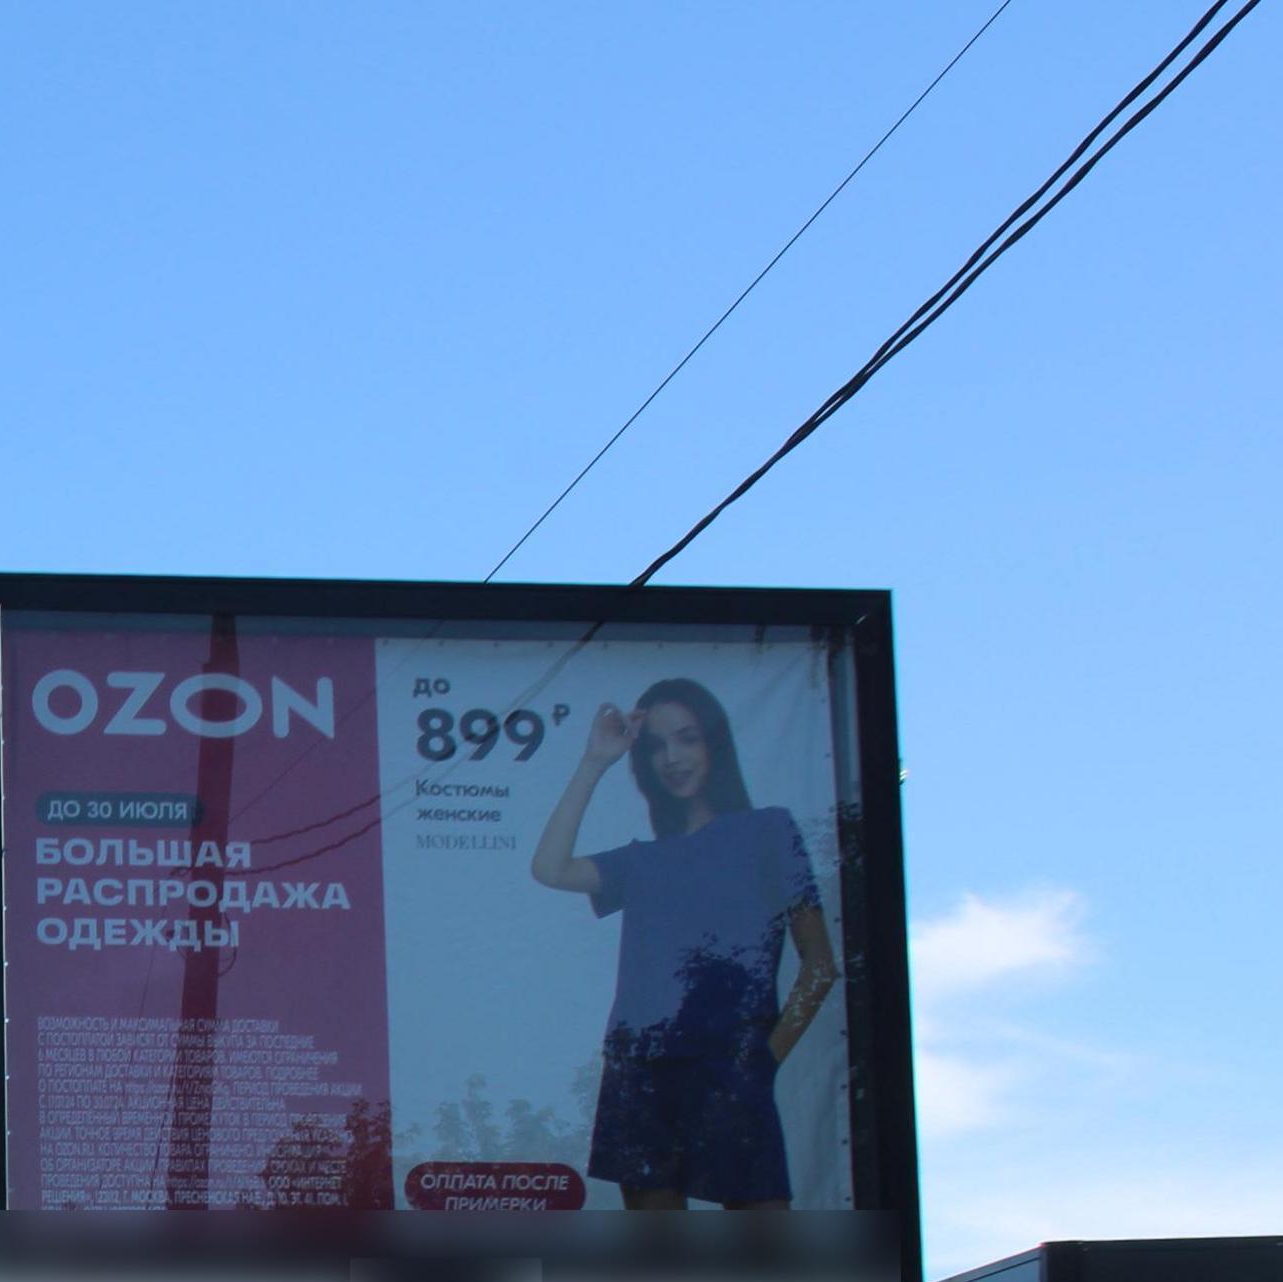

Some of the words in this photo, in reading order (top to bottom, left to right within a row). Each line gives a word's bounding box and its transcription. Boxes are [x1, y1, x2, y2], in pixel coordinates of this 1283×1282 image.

[32, 669, 334, 739] OZON
[415, 780, 510, 799] Костюмы
[47, 800, 80, 820] ДО
[87, 802, 111, 819] 30
[119, 802, 188, 820] ИЮЛЯ
[416, 807, 502, 823] женские
[35, 837, 252, 868] БОЛЬШАЯ
[36, 877, 350, 913] РАСПРОДАЖА
[36, 918, 239, 951] ОДЕЖДЫ
[420, 1173, 496, 1190] ОПЛАТА
[502, 1174, 570, 1191] ПОСЛЕ
[444, 1196, 548, 1211] ПРИМЕРКИ
